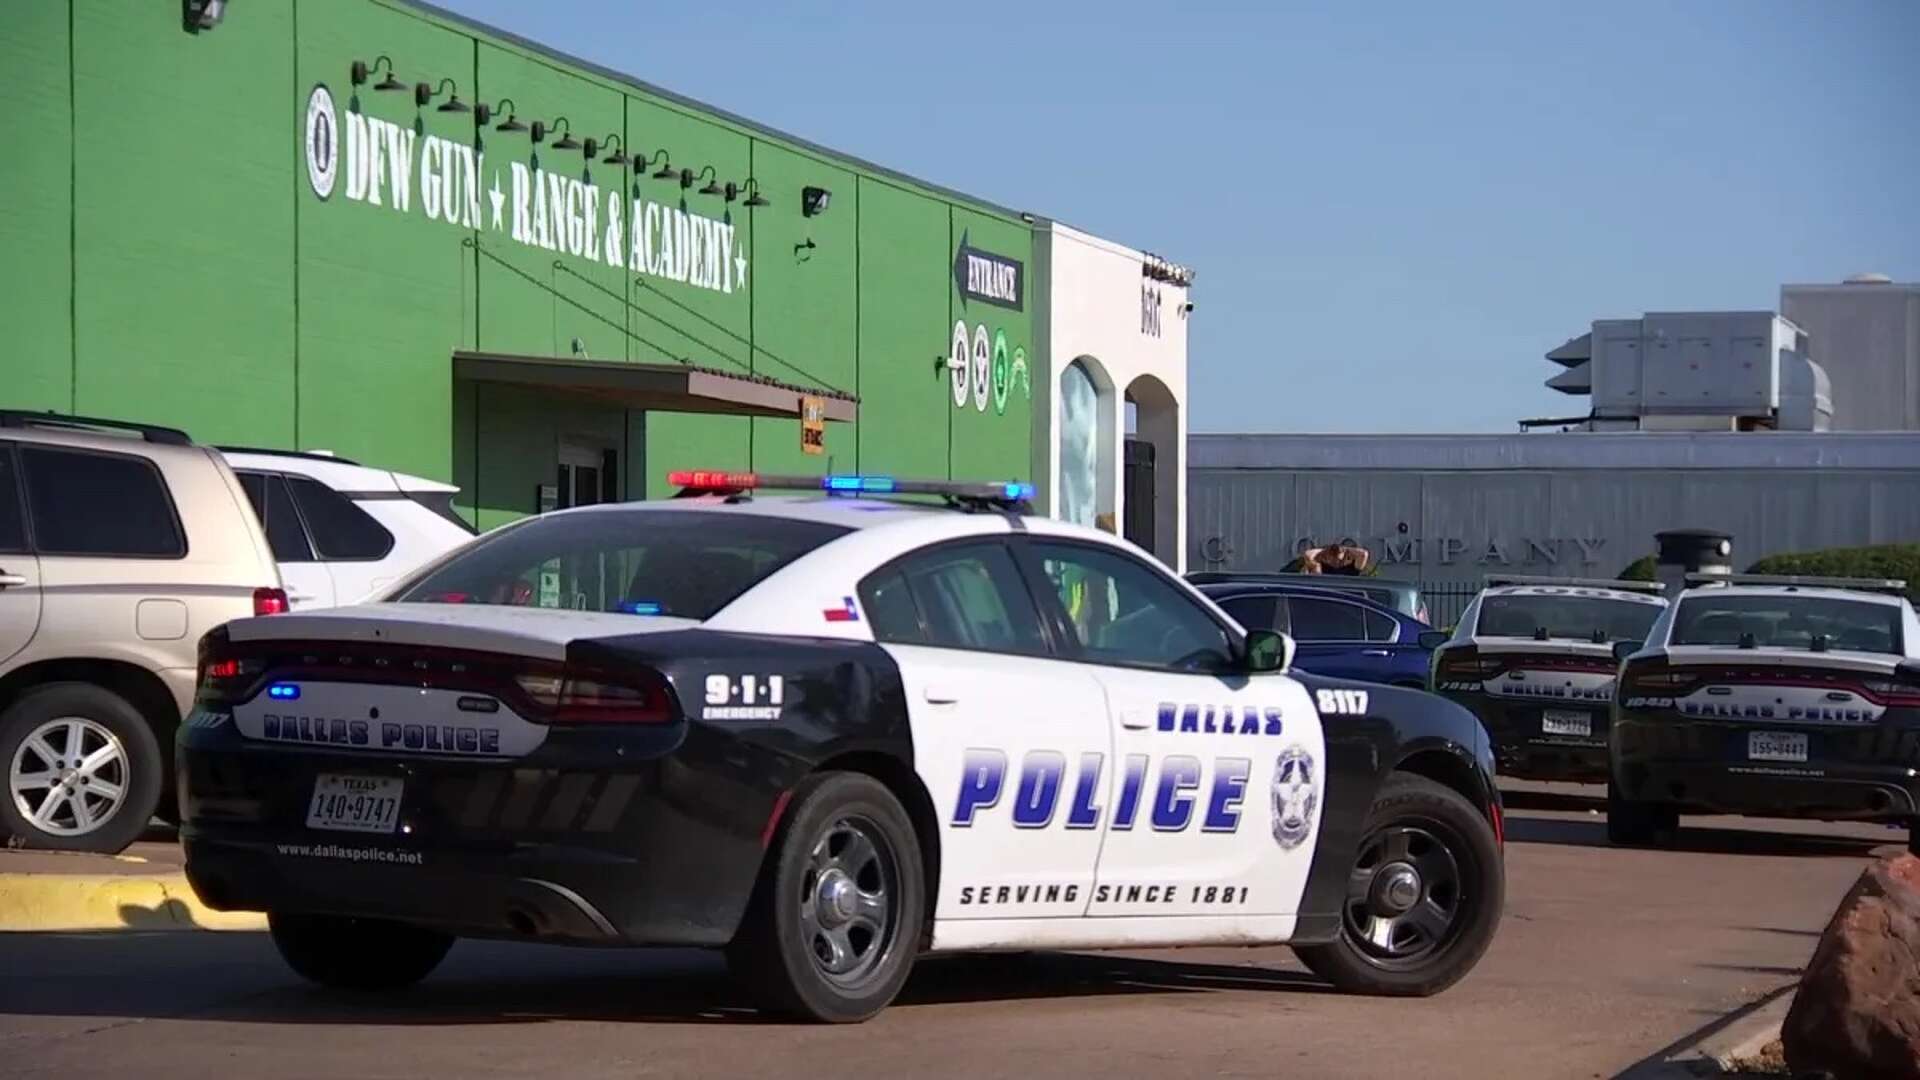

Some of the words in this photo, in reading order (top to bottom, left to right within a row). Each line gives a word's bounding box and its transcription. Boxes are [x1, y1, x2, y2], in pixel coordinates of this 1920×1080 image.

[344, 109, 416, 212] DFW
[420, 134, 484, 230] GUN
[510, 161, 600, 260] RANGE
[605, 190, 624, 268] &
[629, 197, 735, 293] ACADEMY
[967, 254, 1016, 302] ENTRANCE
[703, 707, 782, 720] EMERGENCY
[1316, 688, 1369, 714] 8117
[1685, 703, 1775, 718] DALLAS
[1788, 706, 1873, 721] POLICE
[1156, 702, 1283, 735] DALLAS
[263, 714, 369, 746] DALLAS
[382, 723, 499, 753] POLICE
[343, 780, 377, 792] TEXAS
[949, 748, 1252, 832] POLICE
[277, 844, 423, 865] www.dallaspolice.net
[960, 885, 1079, 905] SERVING
[1095, 885, 1177, 904] SINCE
[1191, 886, 1249, 905] 1881
